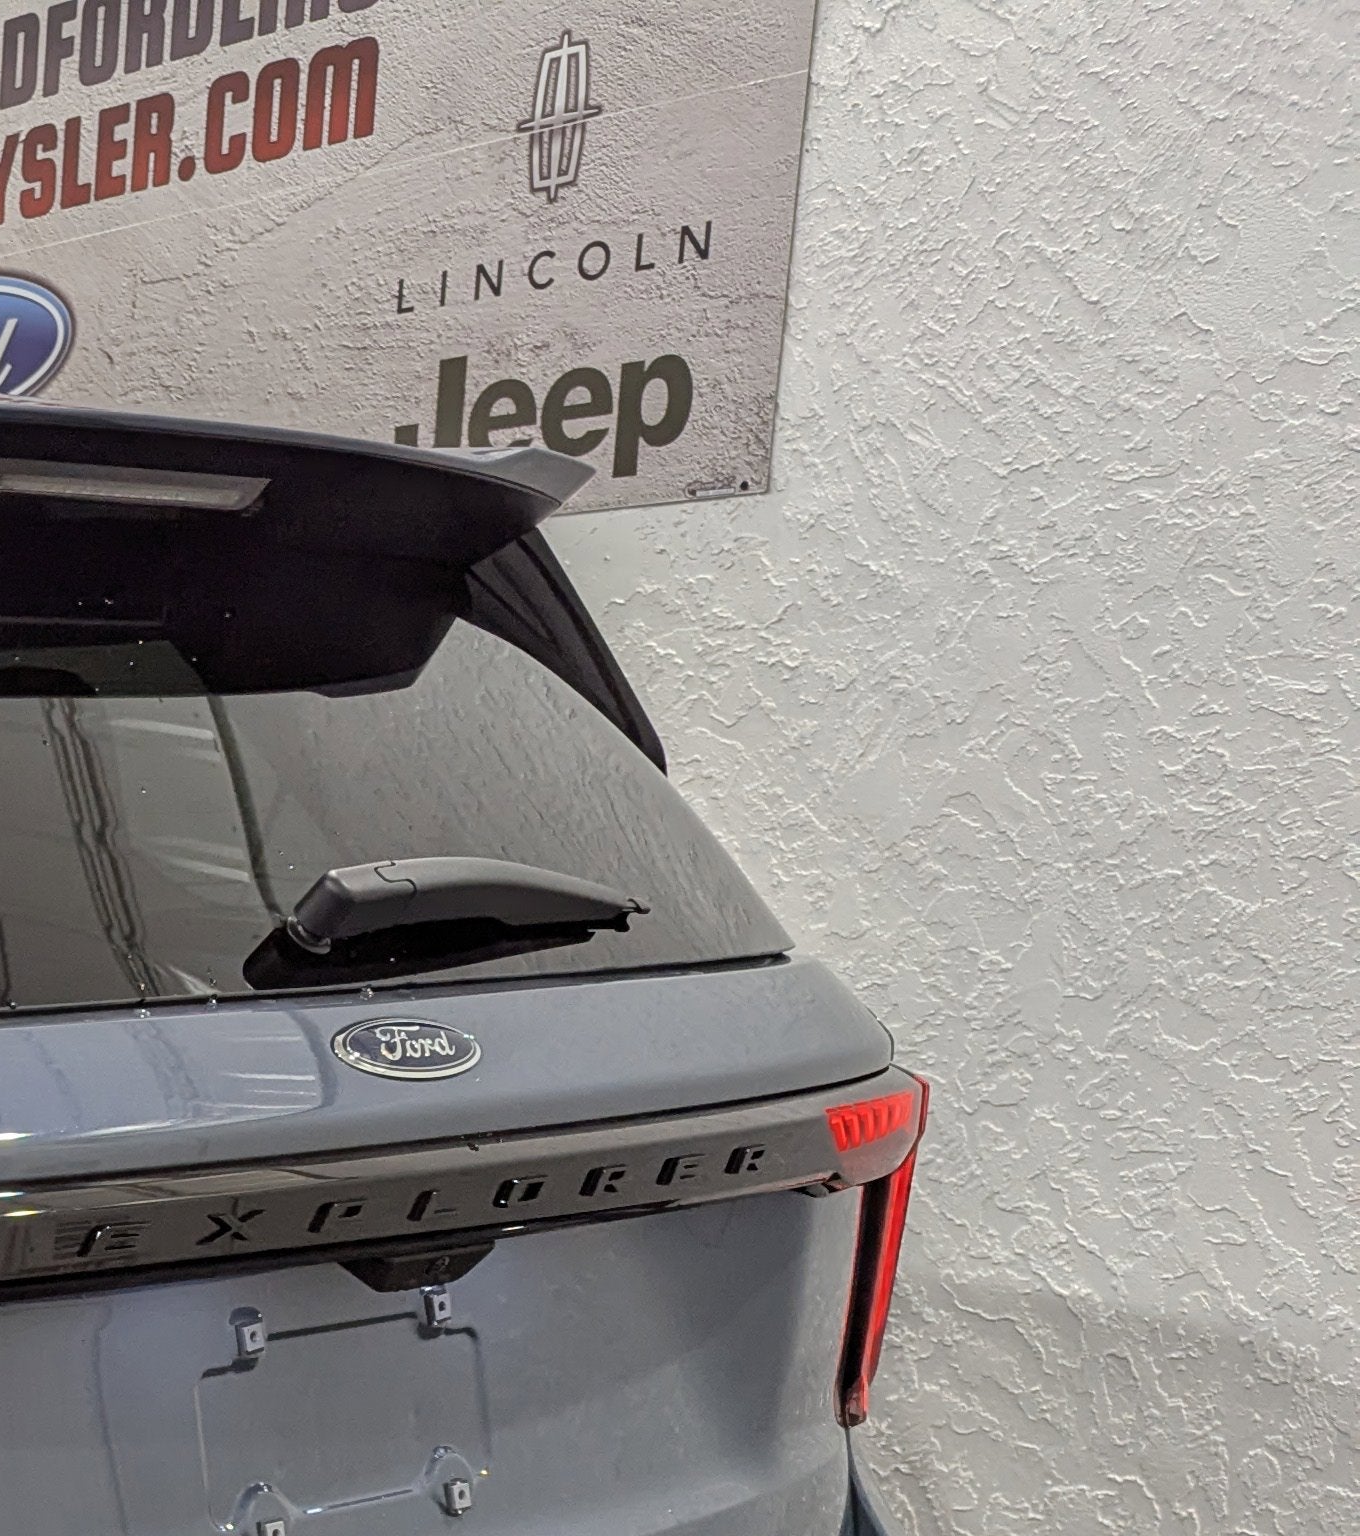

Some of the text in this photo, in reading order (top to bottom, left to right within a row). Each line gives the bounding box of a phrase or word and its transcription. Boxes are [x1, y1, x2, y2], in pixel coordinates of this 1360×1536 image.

[397, 221, 714, 315] LINCOLN
[393, 352, 694, 478] Jeep
[373, 1024, 457, 1062] Ford
[77, 1143, 767, 1258] EXPLORER
